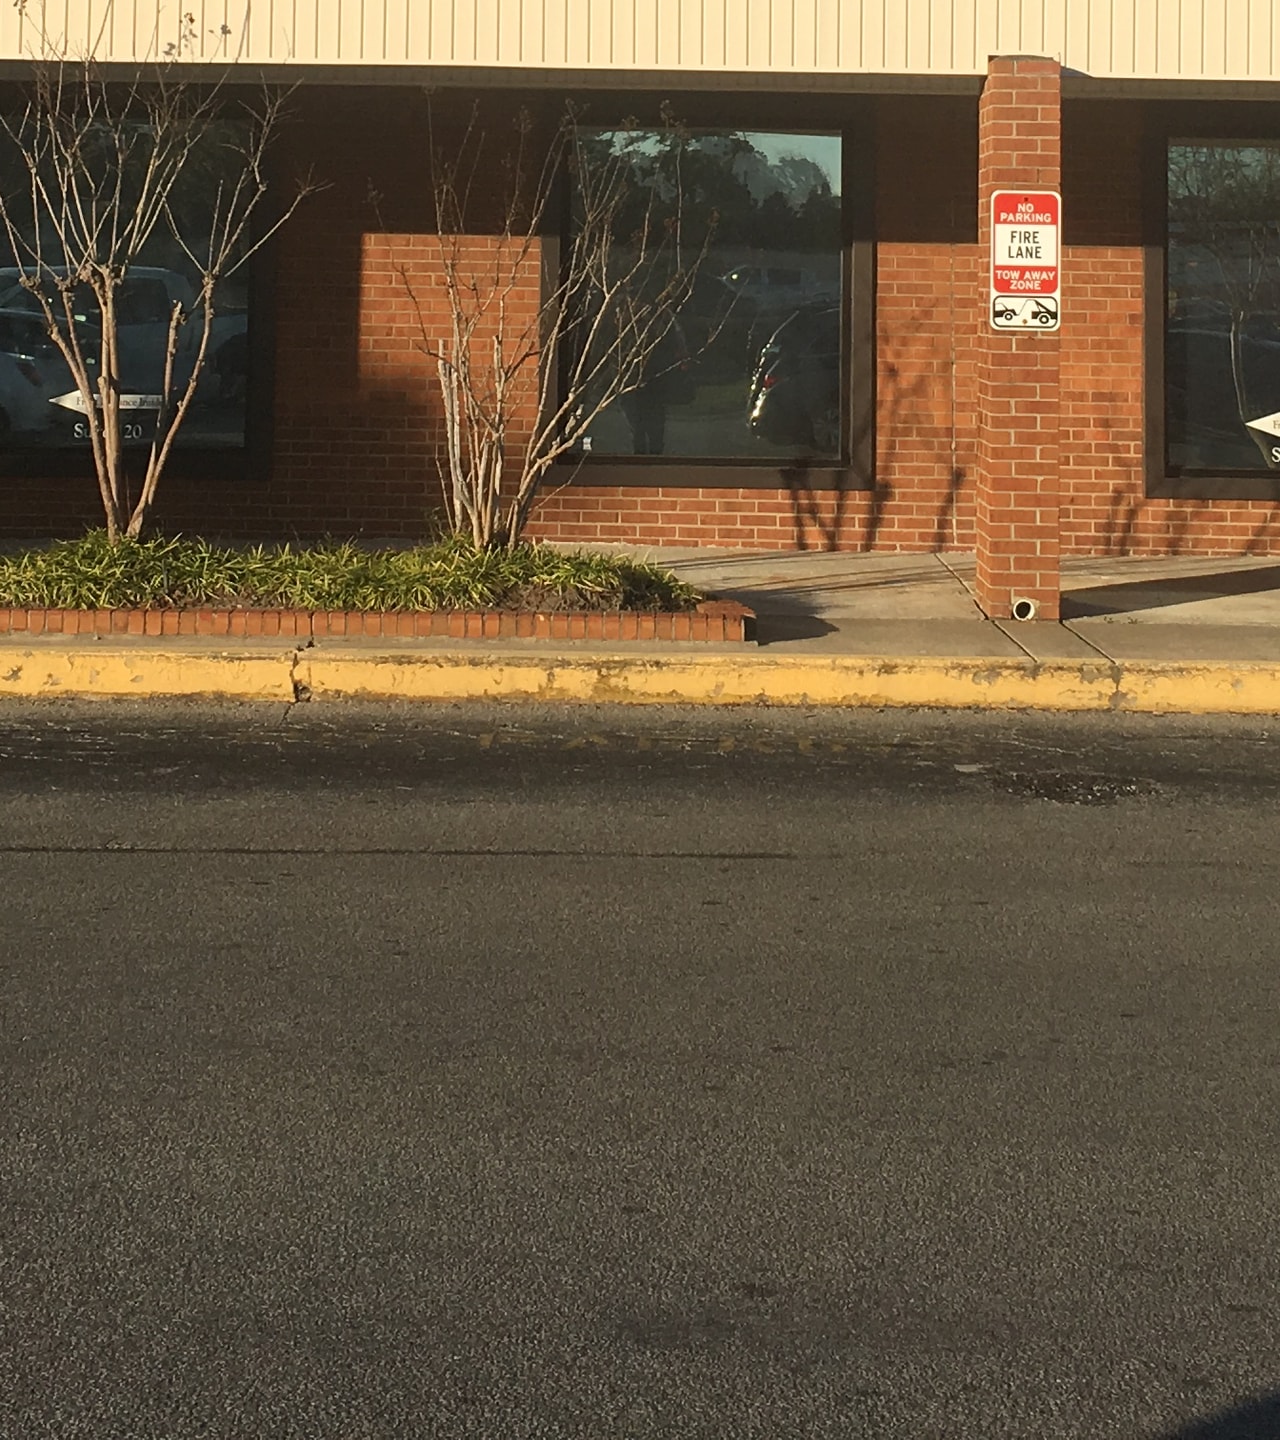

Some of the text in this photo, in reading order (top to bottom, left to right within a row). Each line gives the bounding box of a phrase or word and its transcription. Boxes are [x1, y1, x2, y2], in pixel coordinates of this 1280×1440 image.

[1017, 203, 1034, 213] NO
[1000, 212, 1052, 223] PARKING
[1010, 230, 1040, 244] FIRE
[1008, 245, 1042, 259] LANE
[996, 270, 1056, 281] TOW AWAY
[1009, 280, 1041, 291] ZONE
